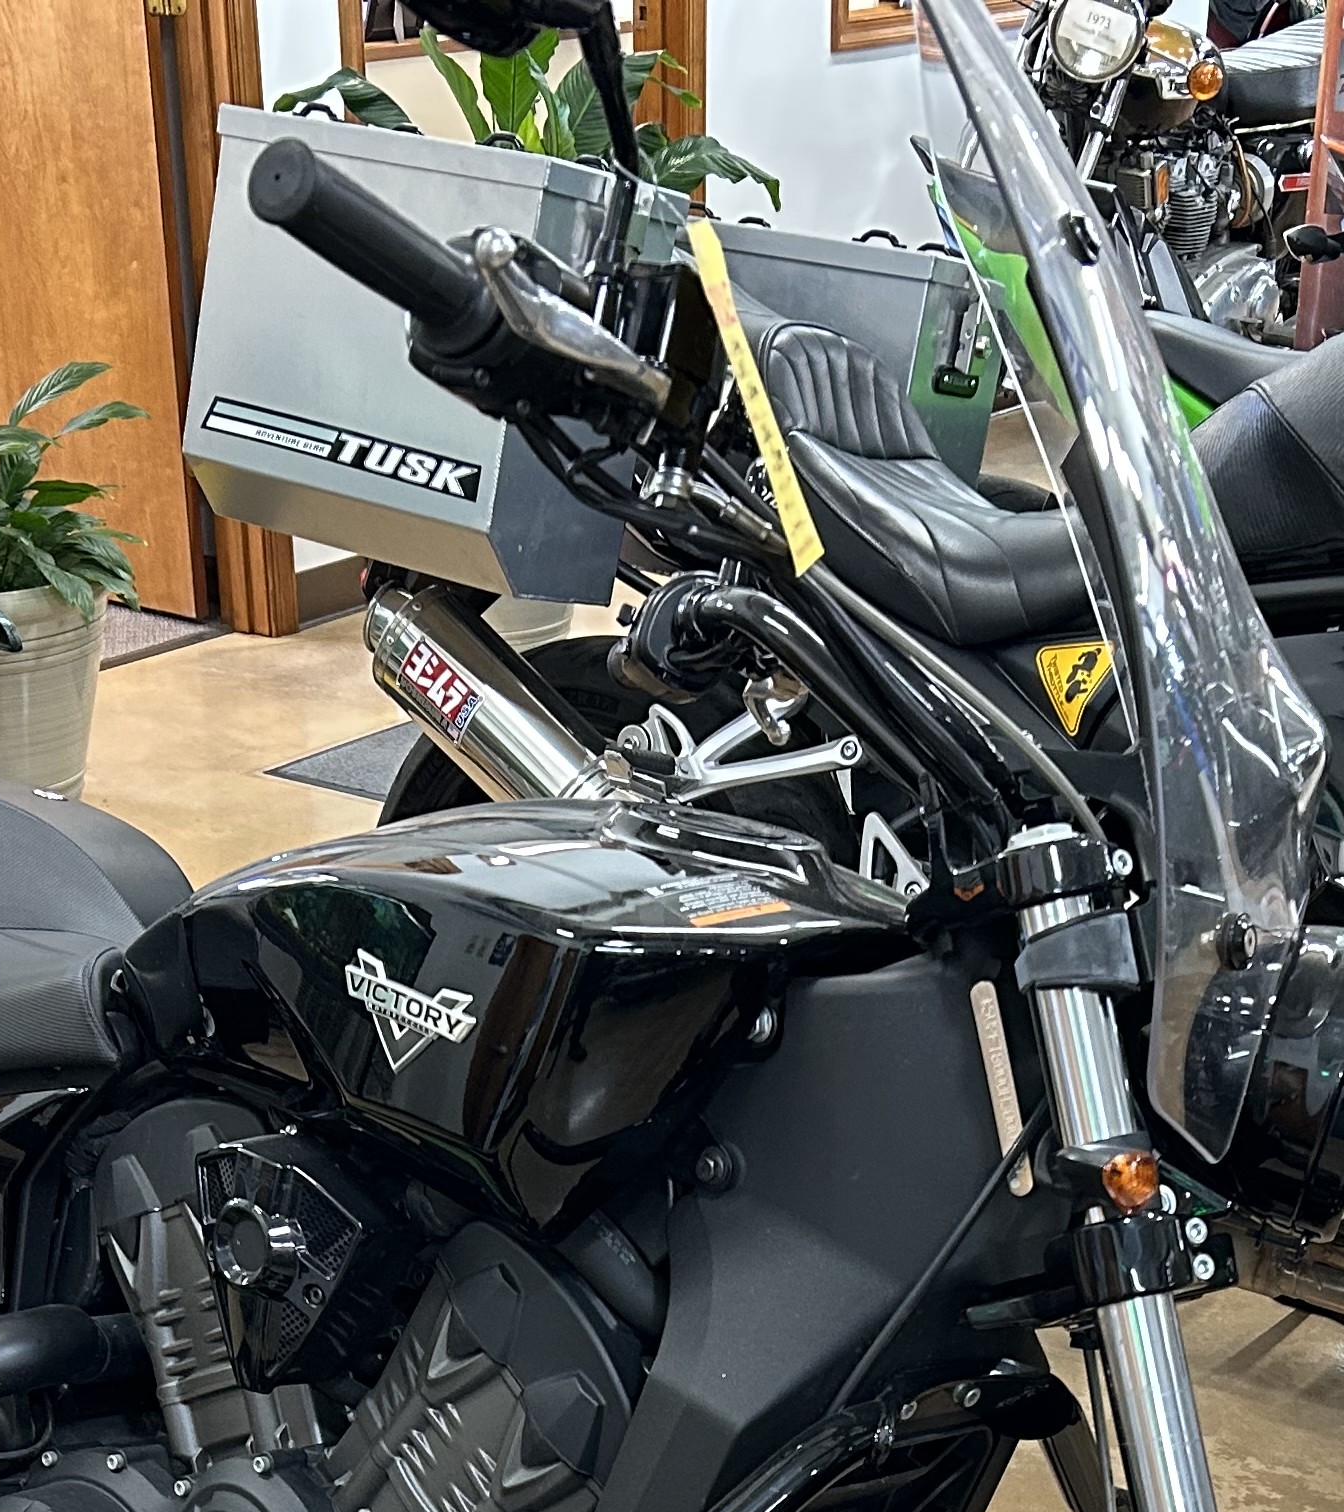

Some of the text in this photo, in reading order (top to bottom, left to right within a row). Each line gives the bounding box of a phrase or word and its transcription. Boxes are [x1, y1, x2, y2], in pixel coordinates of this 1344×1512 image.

[1088, 12, 1112, 29] 1973
[337, 431, 479, 497] TUSK
[455, 694, 479, 729] USA
[350, 972, 463, 1035] VICTORY
